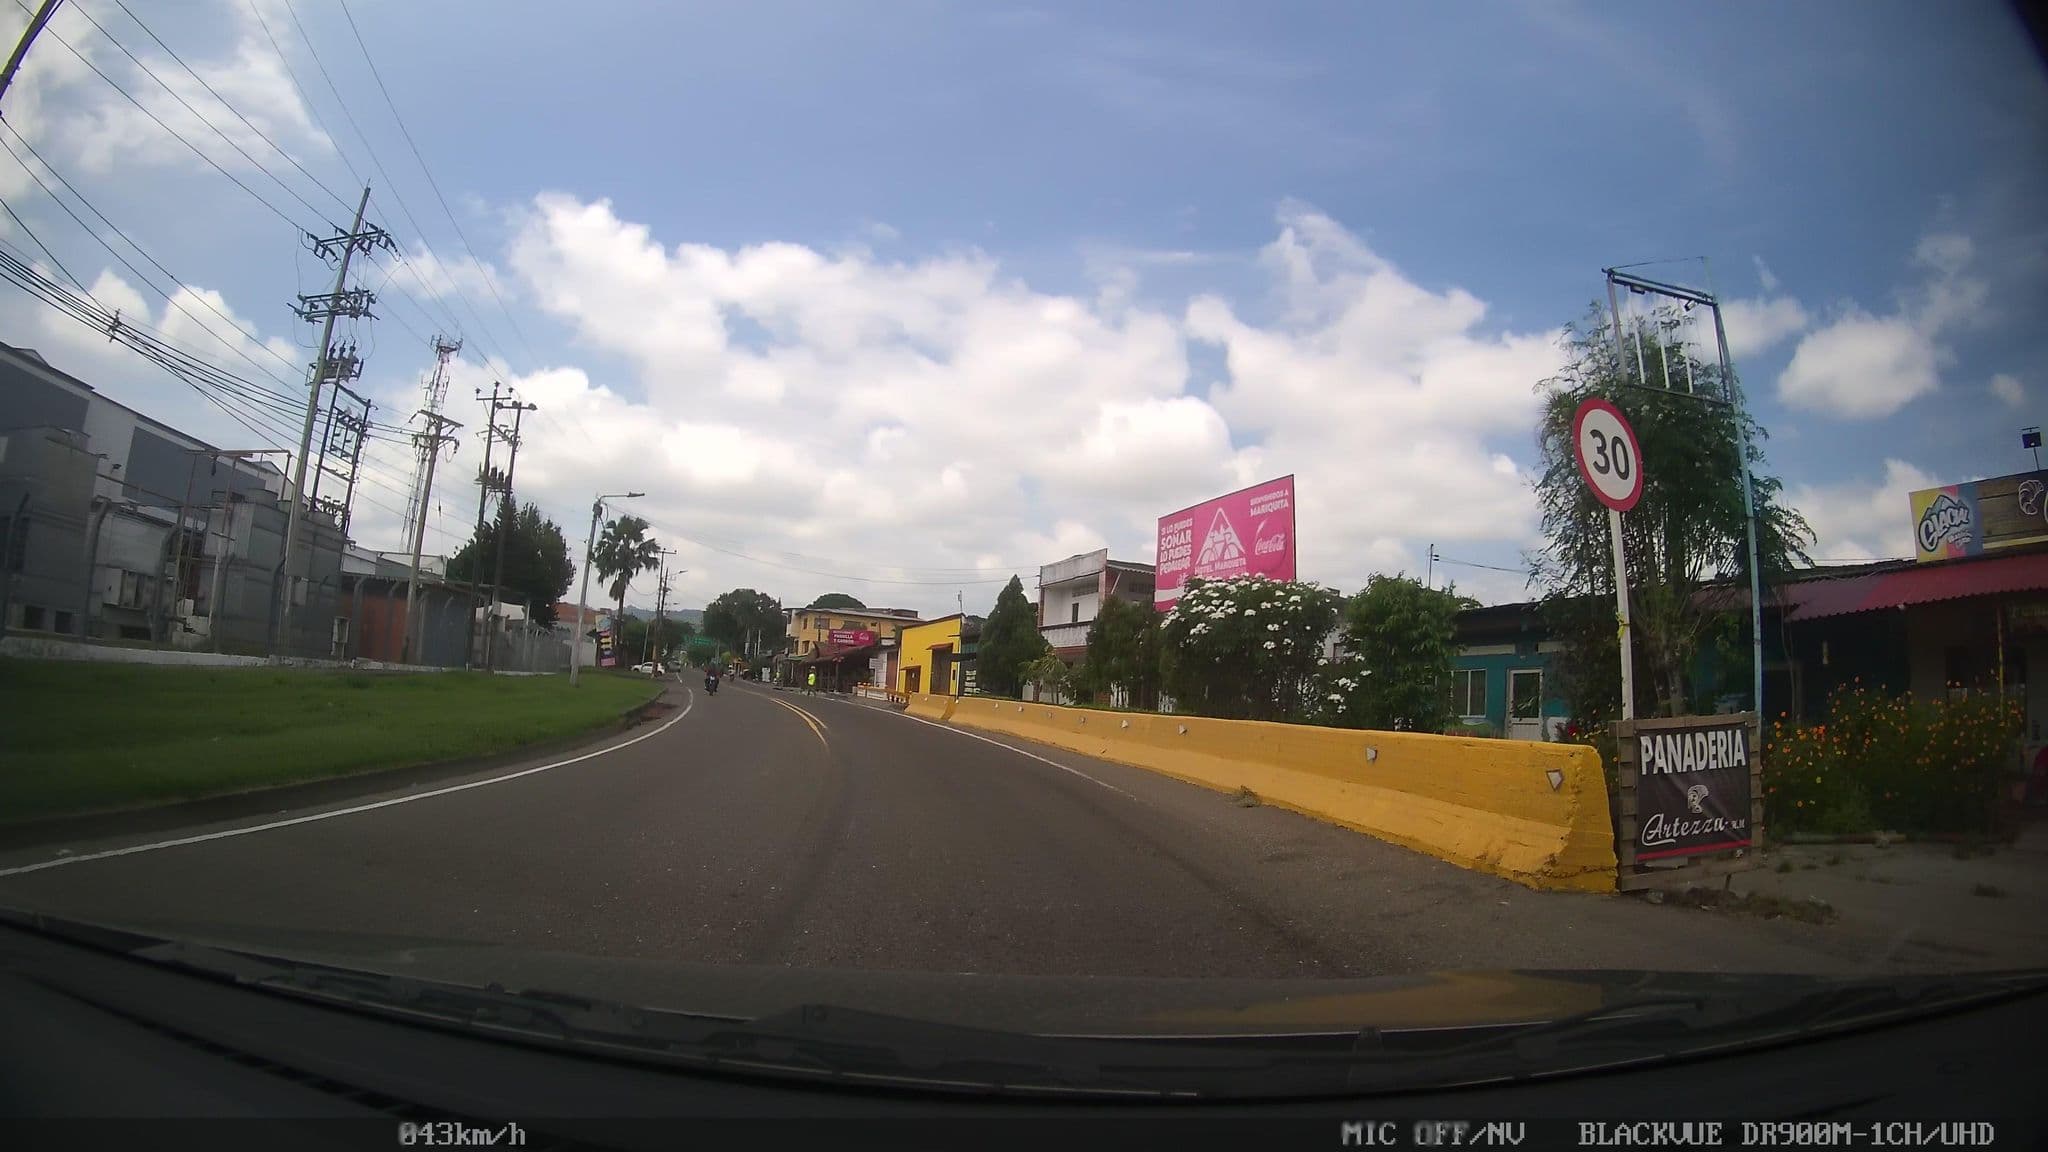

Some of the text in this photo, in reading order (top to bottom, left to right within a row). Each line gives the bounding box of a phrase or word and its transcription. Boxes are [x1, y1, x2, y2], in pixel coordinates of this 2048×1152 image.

[1589, 429, 1630, 480] 30
[1250, 498, 1289, 516] MARIQUITA
[1640, 729, 1746, 775] PANADERIA
